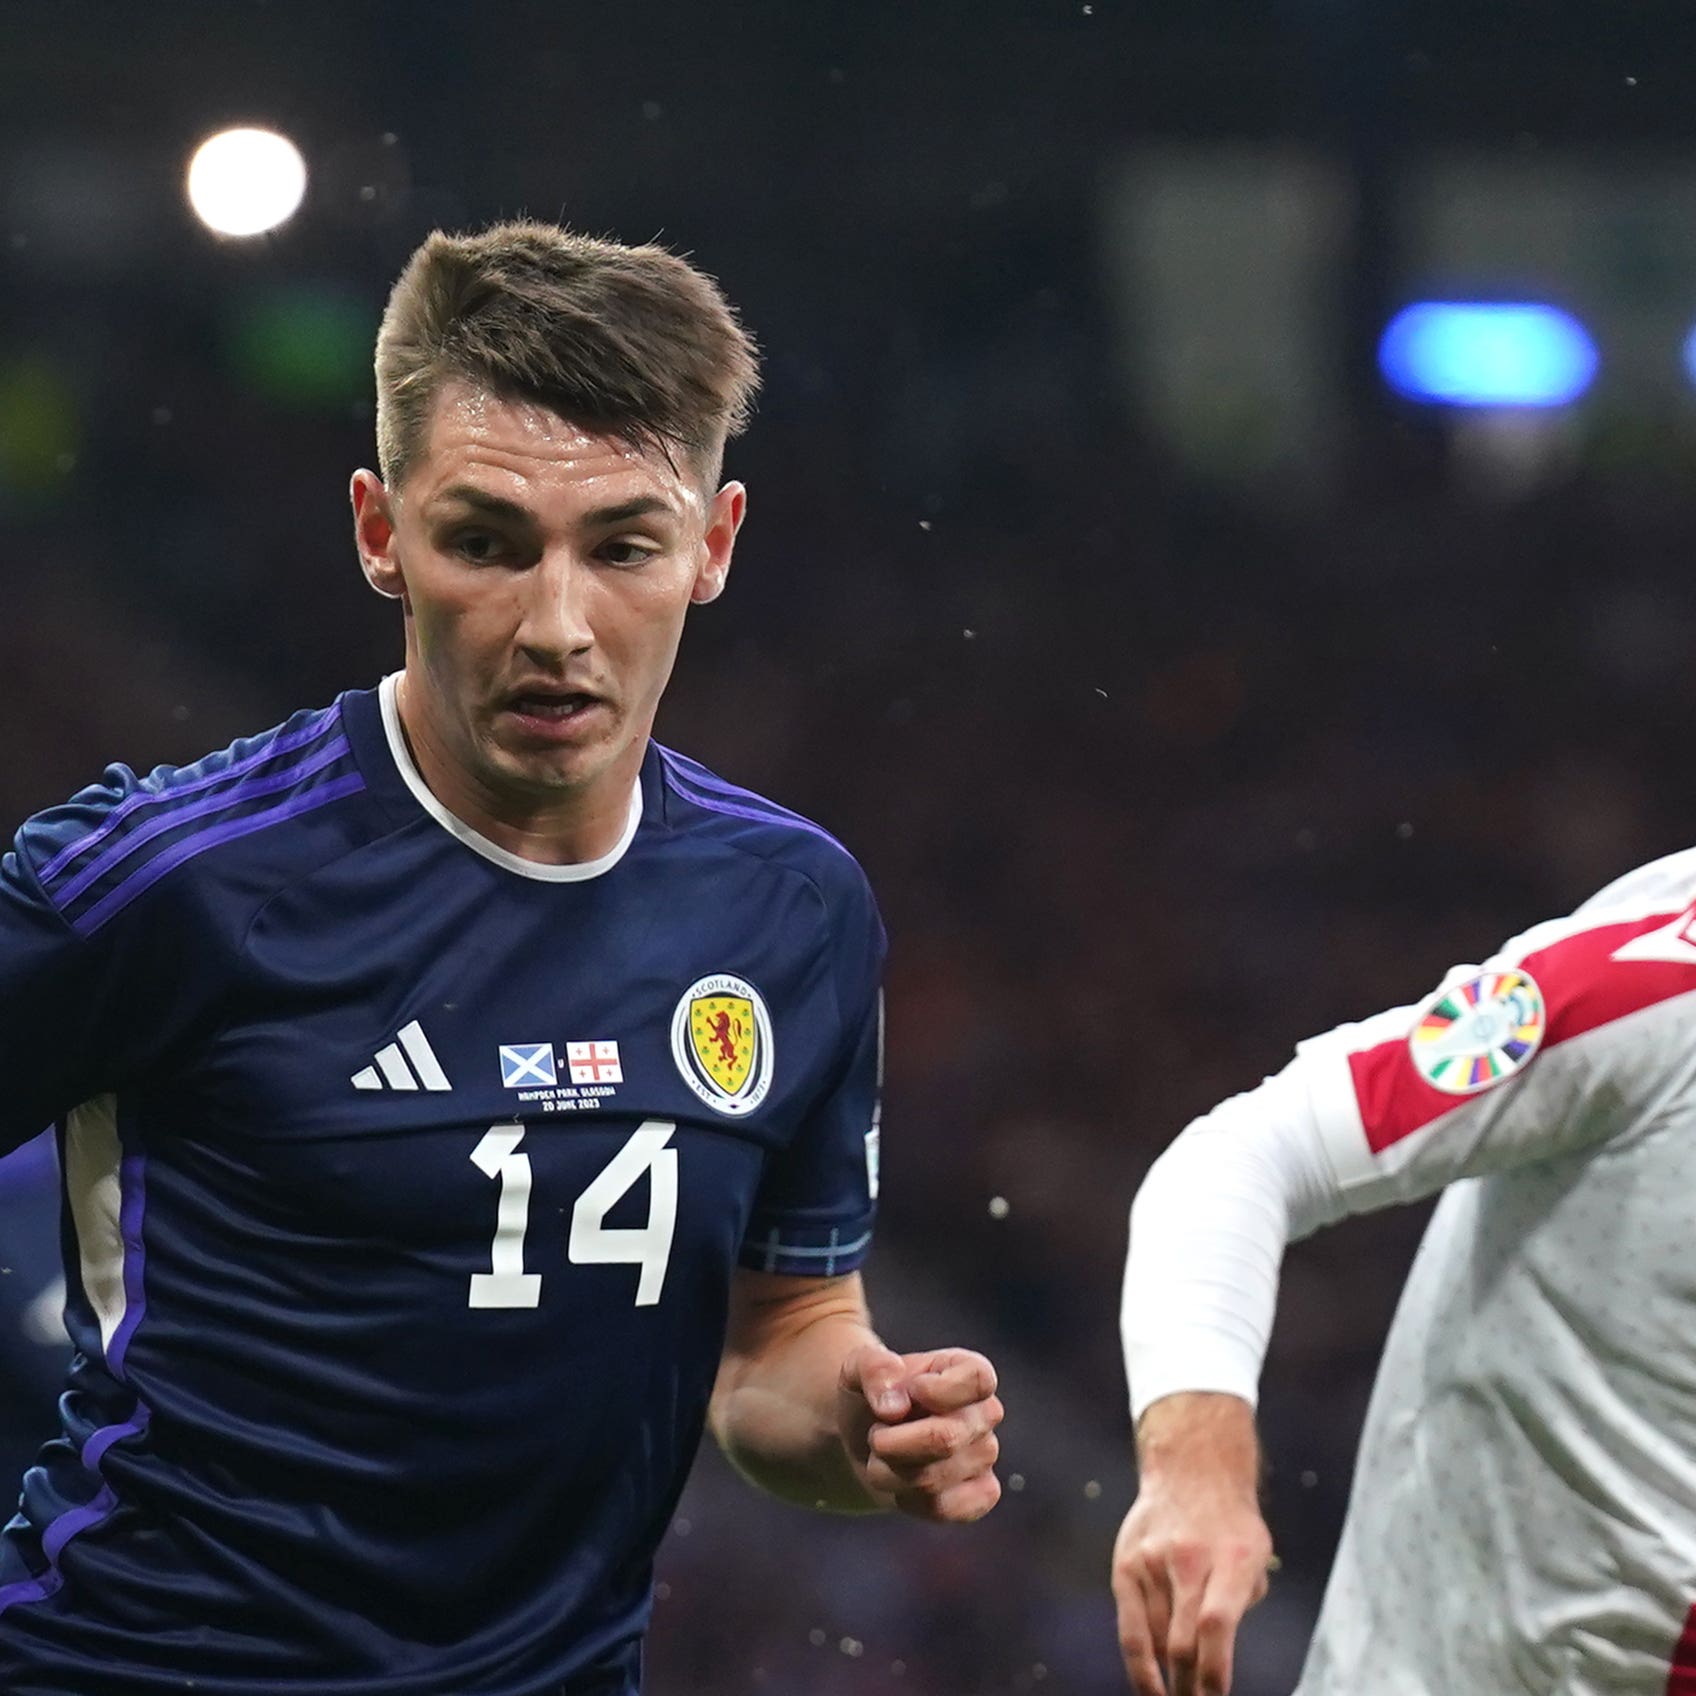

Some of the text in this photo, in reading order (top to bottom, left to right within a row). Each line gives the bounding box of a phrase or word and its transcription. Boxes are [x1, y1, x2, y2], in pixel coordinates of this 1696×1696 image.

[695, 980, 748, 996] SCOTLAND
[543, 1098, 600, 1111] 20 JUNE 2023
[468, 1118, 678, 1308] 14
